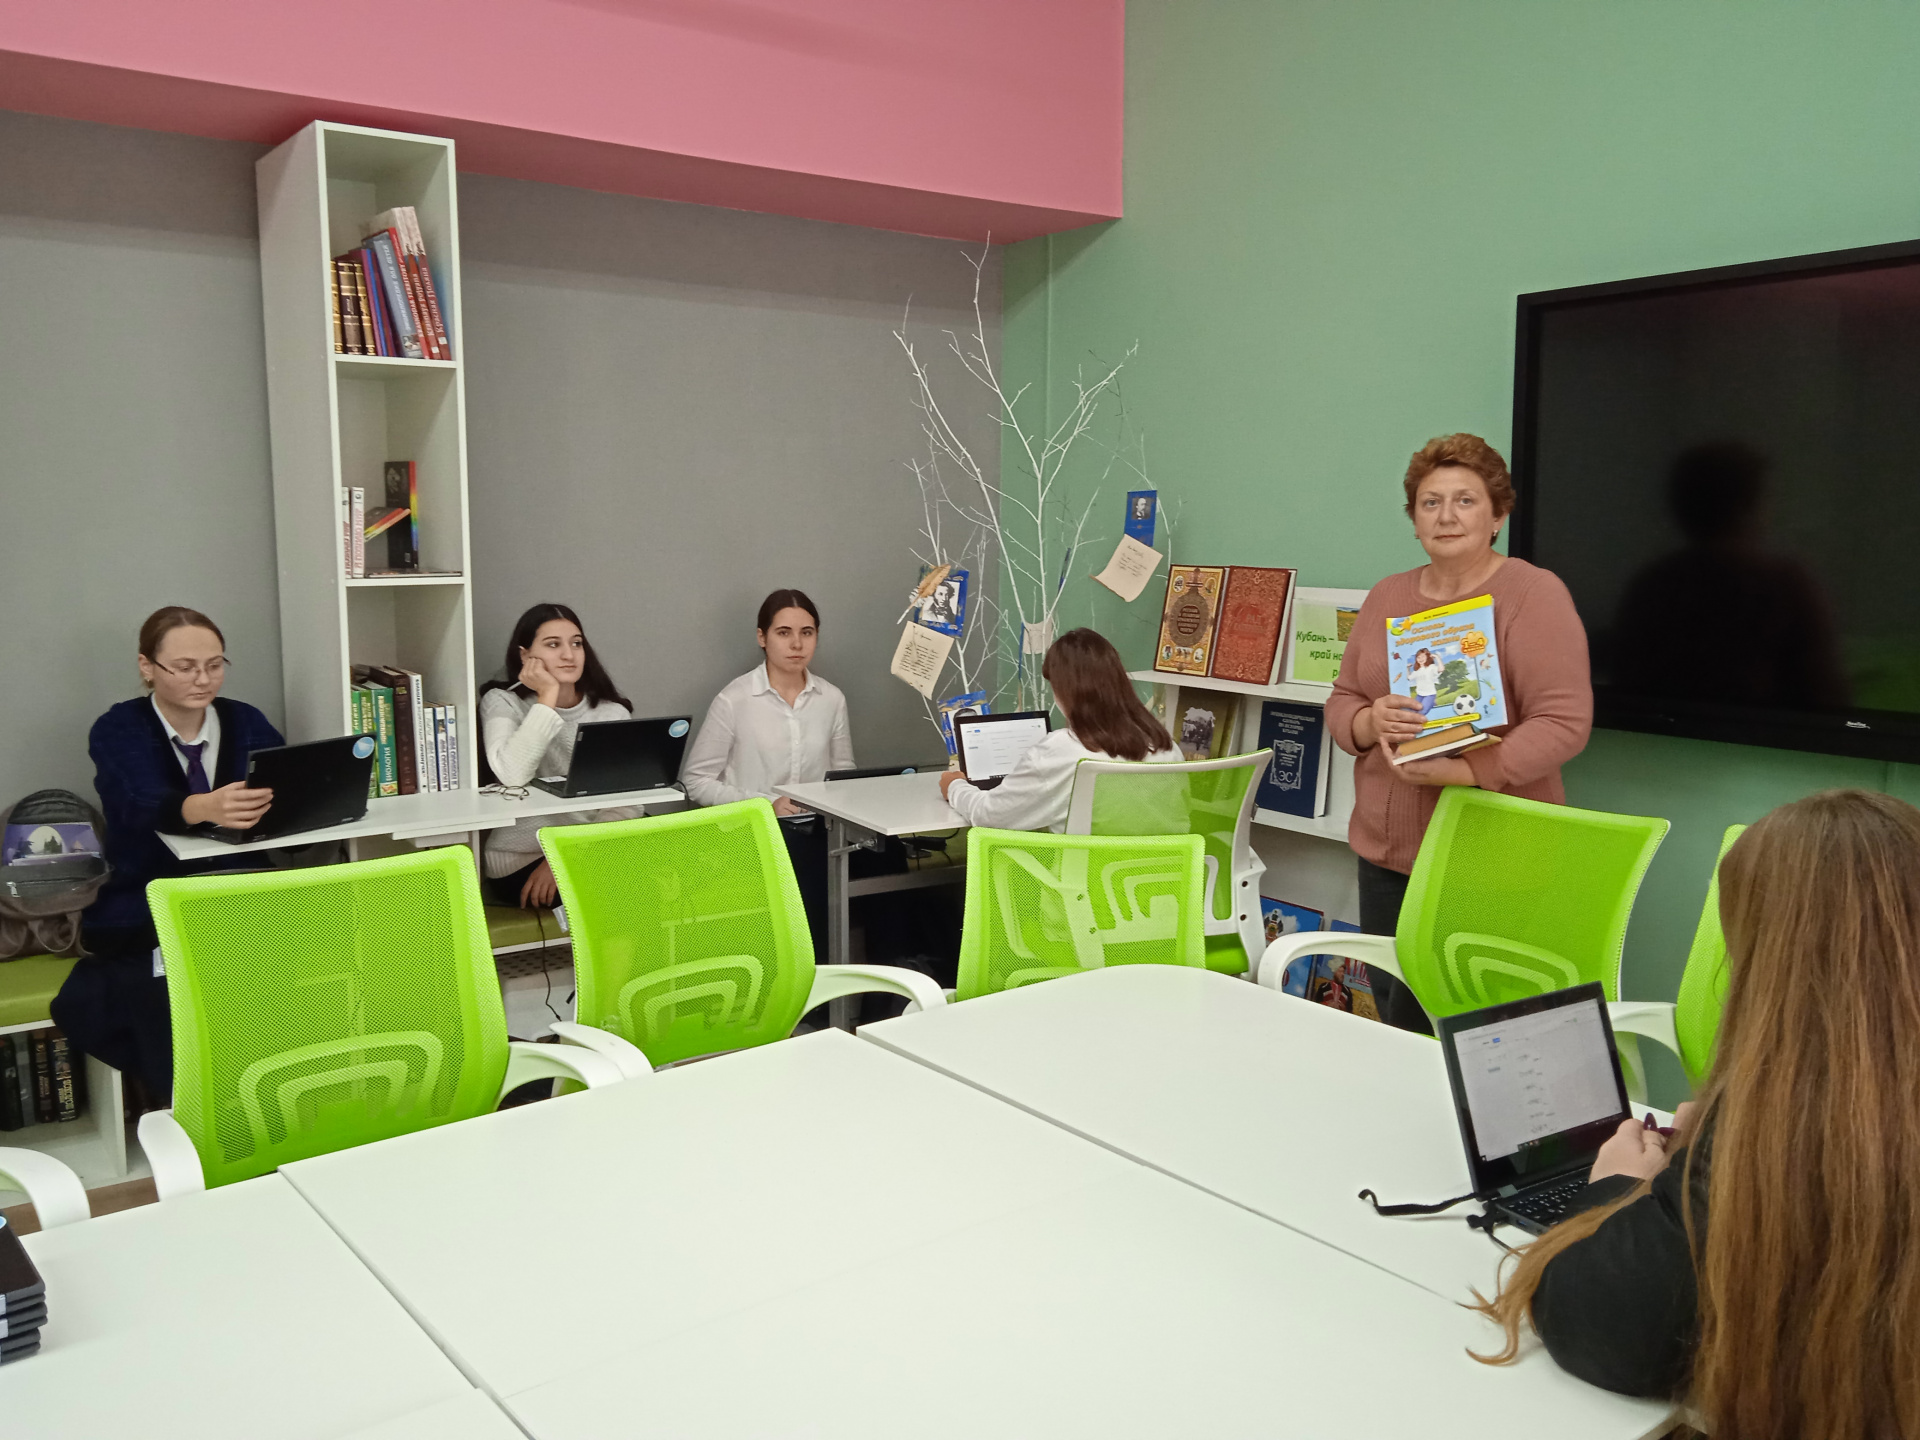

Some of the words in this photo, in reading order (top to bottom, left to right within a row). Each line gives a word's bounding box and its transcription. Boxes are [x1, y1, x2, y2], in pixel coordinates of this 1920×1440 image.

[400, 264, 415, 300] TERRITORY
[410, 300, 425, 338] KRASNODAR
[431, 300, 445, 333] Красная
[1296, 631, 1327, 643] Кубань
[1309, 649, 1331, 660] край
[384, 747, 393, 781] БИОЛОГИЯ
[1278, 770, 1293, 783] ЭС
